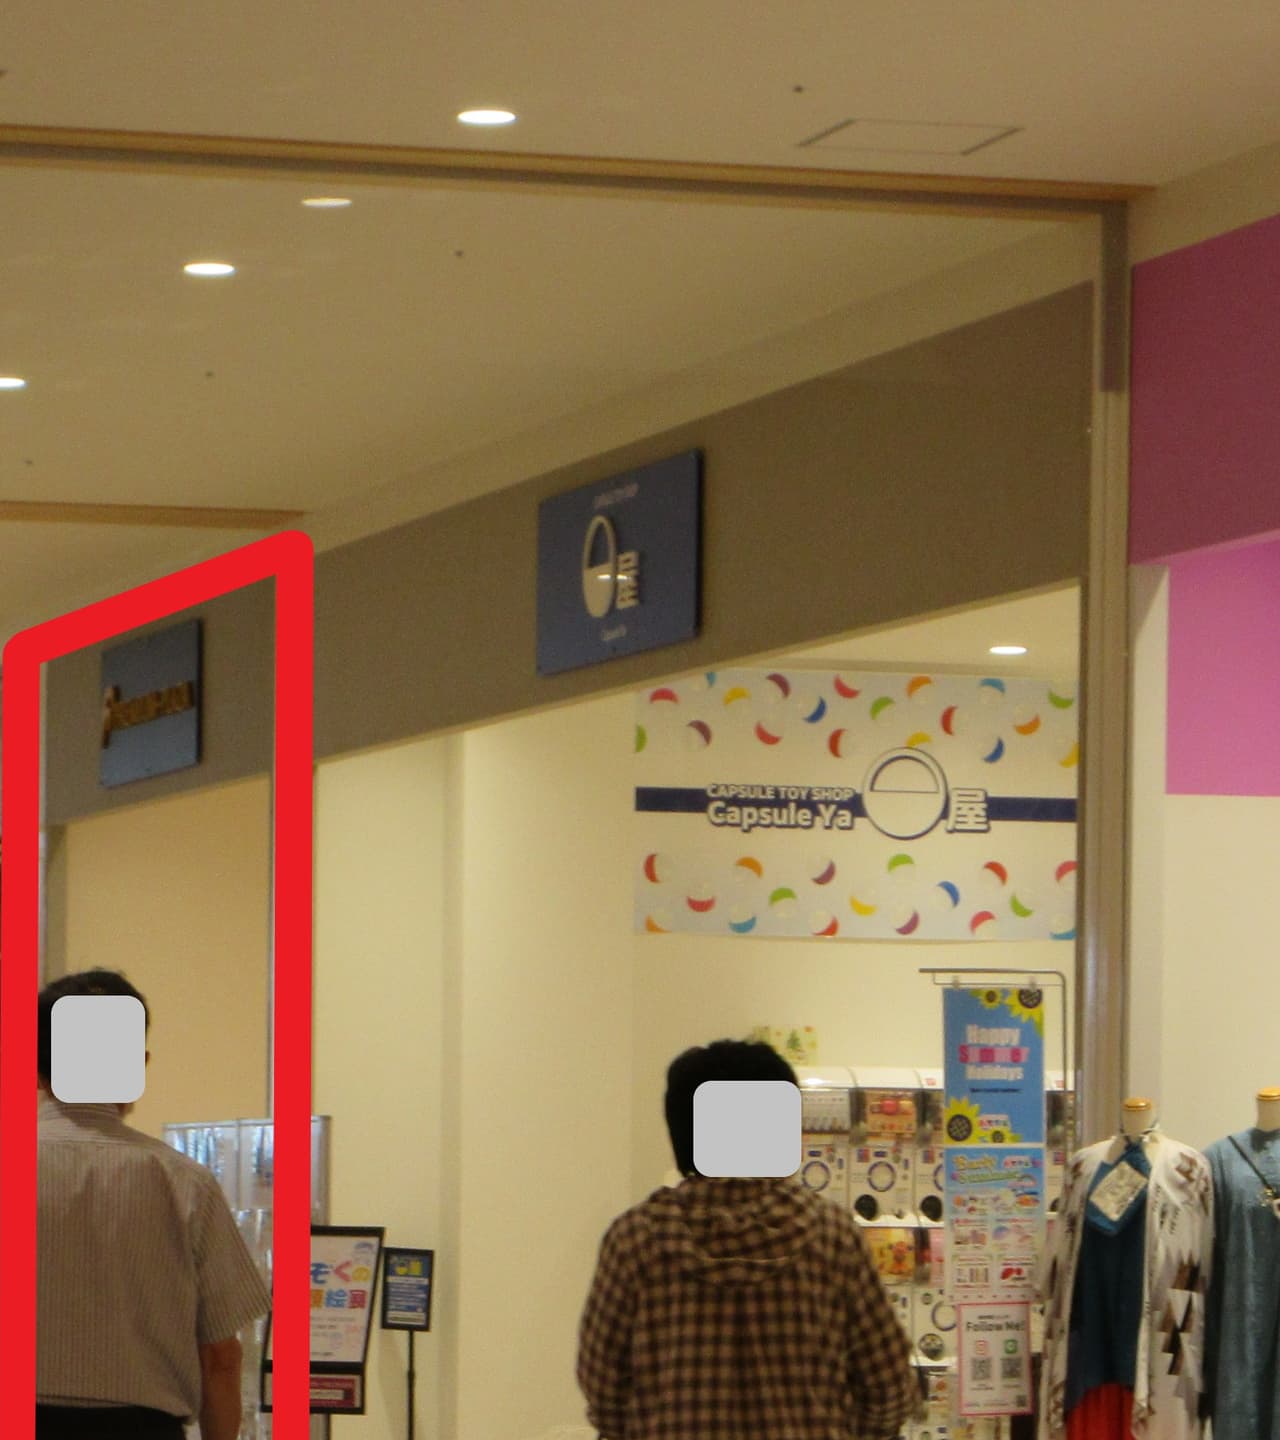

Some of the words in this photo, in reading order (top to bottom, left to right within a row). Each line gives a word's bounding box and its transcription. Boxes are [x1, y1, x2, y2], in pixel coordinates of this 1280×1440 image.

[706, 783, 776, 800] CAPSULE
[778, 784, 808, 801] TOY
[810, 786, 855, 802] SHOP
[707, 801, 813, 832] Capsule
[817, 803, 855, 829] Ya
[947, 787, 991, 834] 屋
